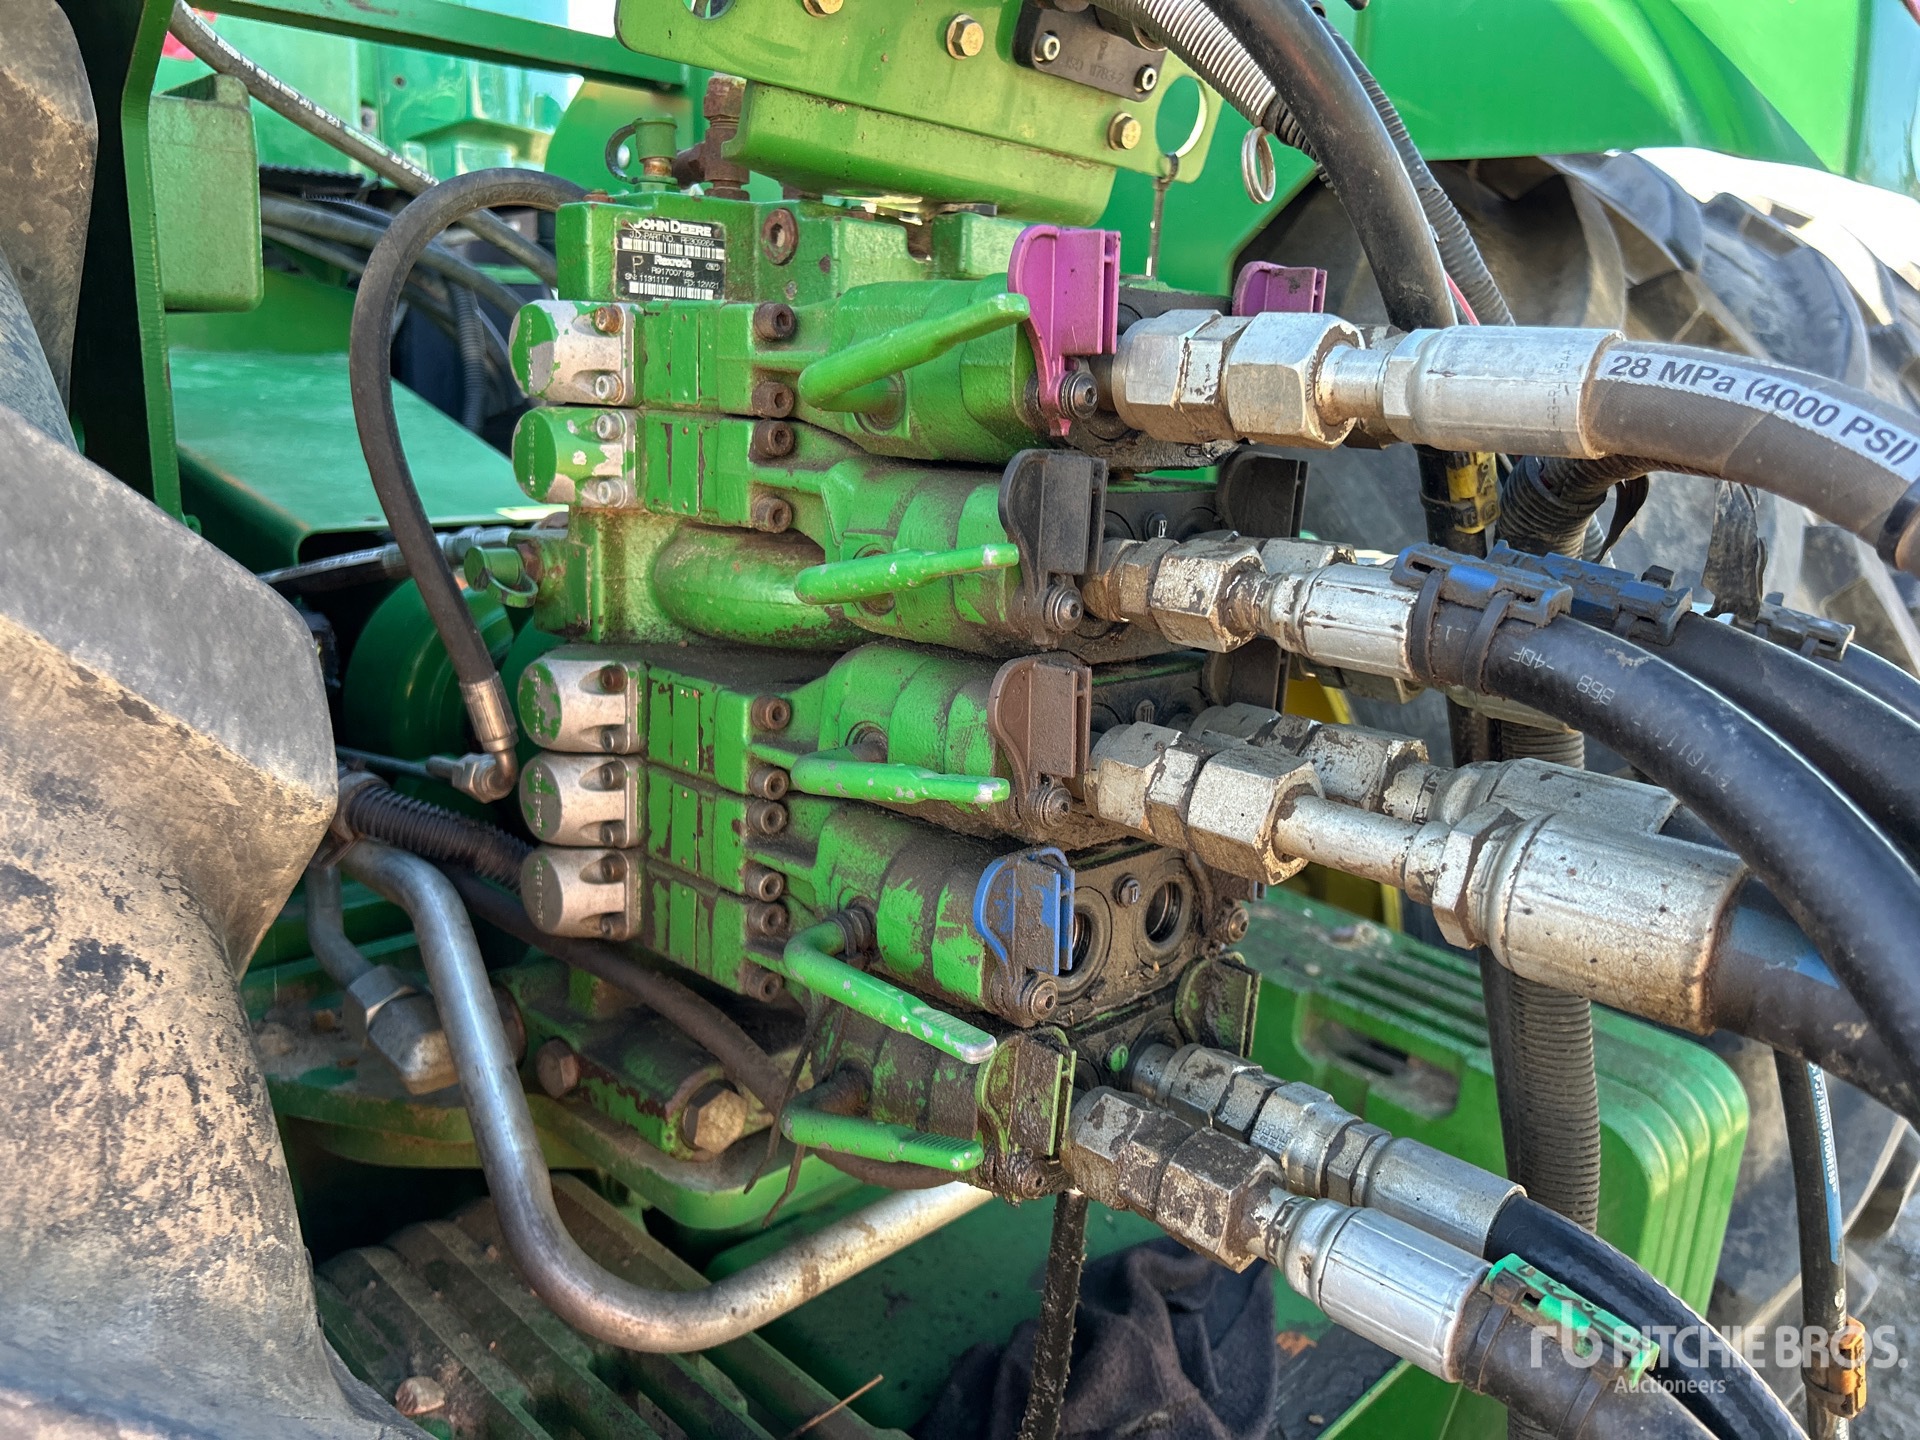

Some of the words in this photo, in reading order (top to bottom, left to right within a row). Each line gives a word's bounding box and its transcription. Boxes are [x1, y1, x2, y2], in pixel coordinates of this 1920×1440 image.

[634, 218, 670, 232] JOHN
[670, 220, 712, 237] DEERE
[654, 255, 692, 268] Rexroth
[1608, 355, 1652, 379] 28
[1657, 361, 1737, 394] MPa
[1744, 377, 1840, 428] (4000
[1840, 415, 1919, 467] PSI)
